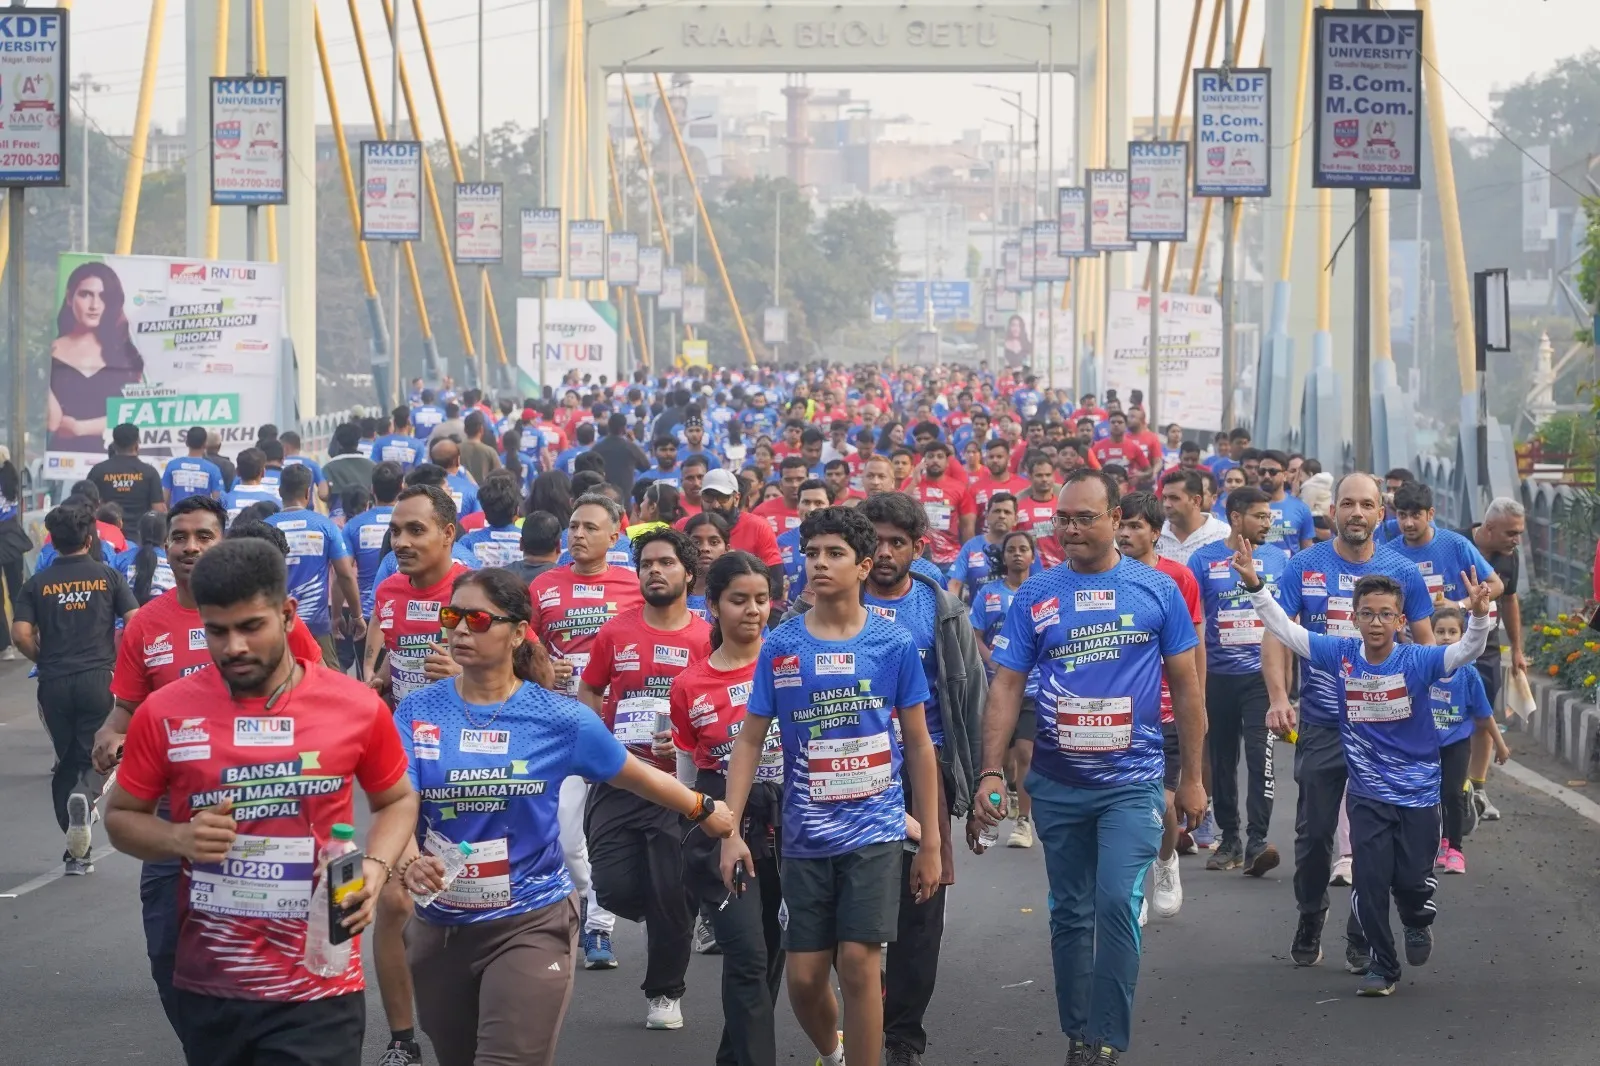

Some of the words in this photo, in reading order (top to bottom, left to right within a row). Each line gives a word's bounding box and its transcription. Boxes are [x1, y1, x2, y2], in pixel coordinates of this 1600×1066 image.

[681, 21, 782, 48] RAJA
[796, 21, 890, 48] BHOJ
[906, 20, 997, 48] SETU
[1329, 23, 1415, 45] RKDF
[1329, 48, 1414, 60] UNIVERSITY
[1360, 62, 1381, 70] Nagar,
[22, 74, 43, 94] A+
[217, 80, 282, 94] RKDF
[1202, 78, 1264, 92] RKDF
[1328, 74, 1412, 92] B.Com.
[218, 97, 281, 105] UNIVERSITY
[1326, 97, 1413, 116] M.Com.
[10, 114, 43, 123] NAAC
[1203, 114, 1263, 126] B.Com.
[1373, 120, 1389, 134] A+
[1202, 130, 1264, 142] M.Com.
[12, 140, 40, 148] Free:
[368, 144, 418, 156] RKDF
[1132, 144, 1182, 156] RKDF
[1357, 164, 1412, 172] 1800-2700-320
[1094, 172, 1124, 182] RKD
[459, 184, 500, 195] RKDF
[211, 266, 247, 280] RNTU
[174, 304, 220, 316] BANSAL
[142, 318, 182, 332] PANKH
[184, 315, 252, 330] MARATHON
[538, 323, 596, 332] RESENTED
[176, 332, 220, 344] BHOPAL
[118, 399, 232, 424] FATIMA
[104, 472, 143, 482] ANYTIME
[112, 480, 134, 488] 24X7
[42, 580, 107, 596] ANYTIME
[58, 591, 92, 604] 24X7
[1076, 592, 1106, 602] RNTU
[65, 602, 86, 610] GYM
[408, 602, 432, 612] RNTU
[568, 607, 604, 616] BANSAL
[578, 616, 612, 626] MARAT
[190, 630, 206, 640] RN
[572, 628, 600, 636] BHOPA
[1070, 622, 1118, 638] BANSAL
[400, 634, 438, 646] BANSAL
[1049, 642, 1082, 658] PANKH
[1084, 632, 1149, 650] MARATHON
[656, 646, 681, 656] RNTU
[1076, 650, 1120, 664] BHOPAL
[816, 654, 846, 664] RNTU
[398, 672, 431, 684] 1206
[648, 677, 674, 686] BANS
[812, 686, 856, 702] BANSAL
[1362, 692, 1388, 702] 6142
[794, 706, 822, 720] PANKH
[824, 698, 884, 714] MARATHON
[628, 712, 656, 722] 1243
[820, 716, 860, 729] BHOPAL
[1078, 716, 1112, 726] 8510
[172, 728, 204, 738] BANSAL
[237, 720, 280, 732] RNTU
[462, 730, 498, 742] RNTU
[831, 756, 870, 770] 6194
[226, 762, 296, 782] BANSAL
[450, 768, 508, 782] BANSAL
[192, 790, 242, 806] PANKH
[246, 778, 342, 800] MARATHON
[464, 782, 544, 798] MARATHON
[235, 802, 298, 821] BHOPAL
[456, 801, 507, 812] BHOPAL
[221, 861, 284, 880] 10280
[459, 864, 480, 878] 93
[194, 883, 212, 892] AGE
[196, 893, 208, 902] 23
[194, 903, 221, 914] BANSAL
[222, 907, 246, 916] PANKH
[246, 910, 289, 918] MARATHON
